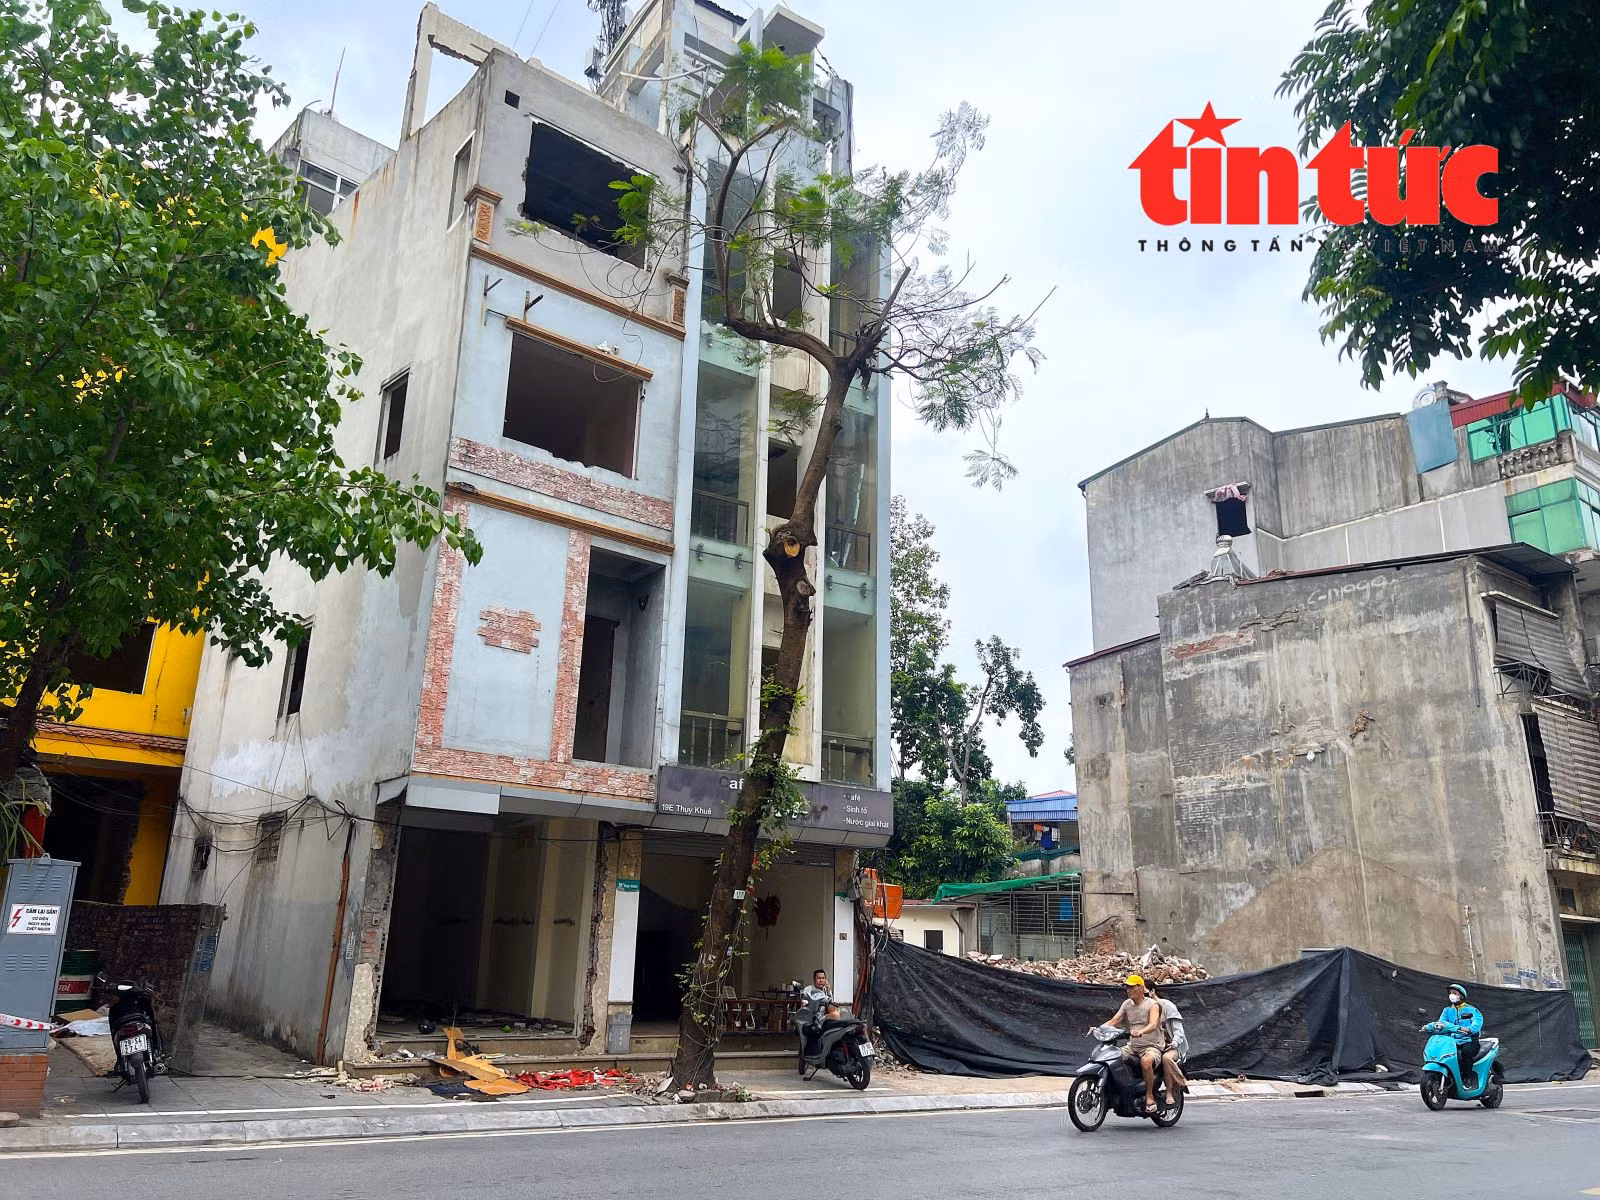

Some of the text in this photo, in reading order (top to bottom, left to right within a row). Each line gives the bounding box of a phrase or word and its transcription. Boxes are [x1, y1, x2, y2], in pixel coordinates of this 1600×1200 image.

[719, 776, 744, 790] Caf
[661, 803, 674, 811] 19E
[676, 804, 693, 815] Thụy
